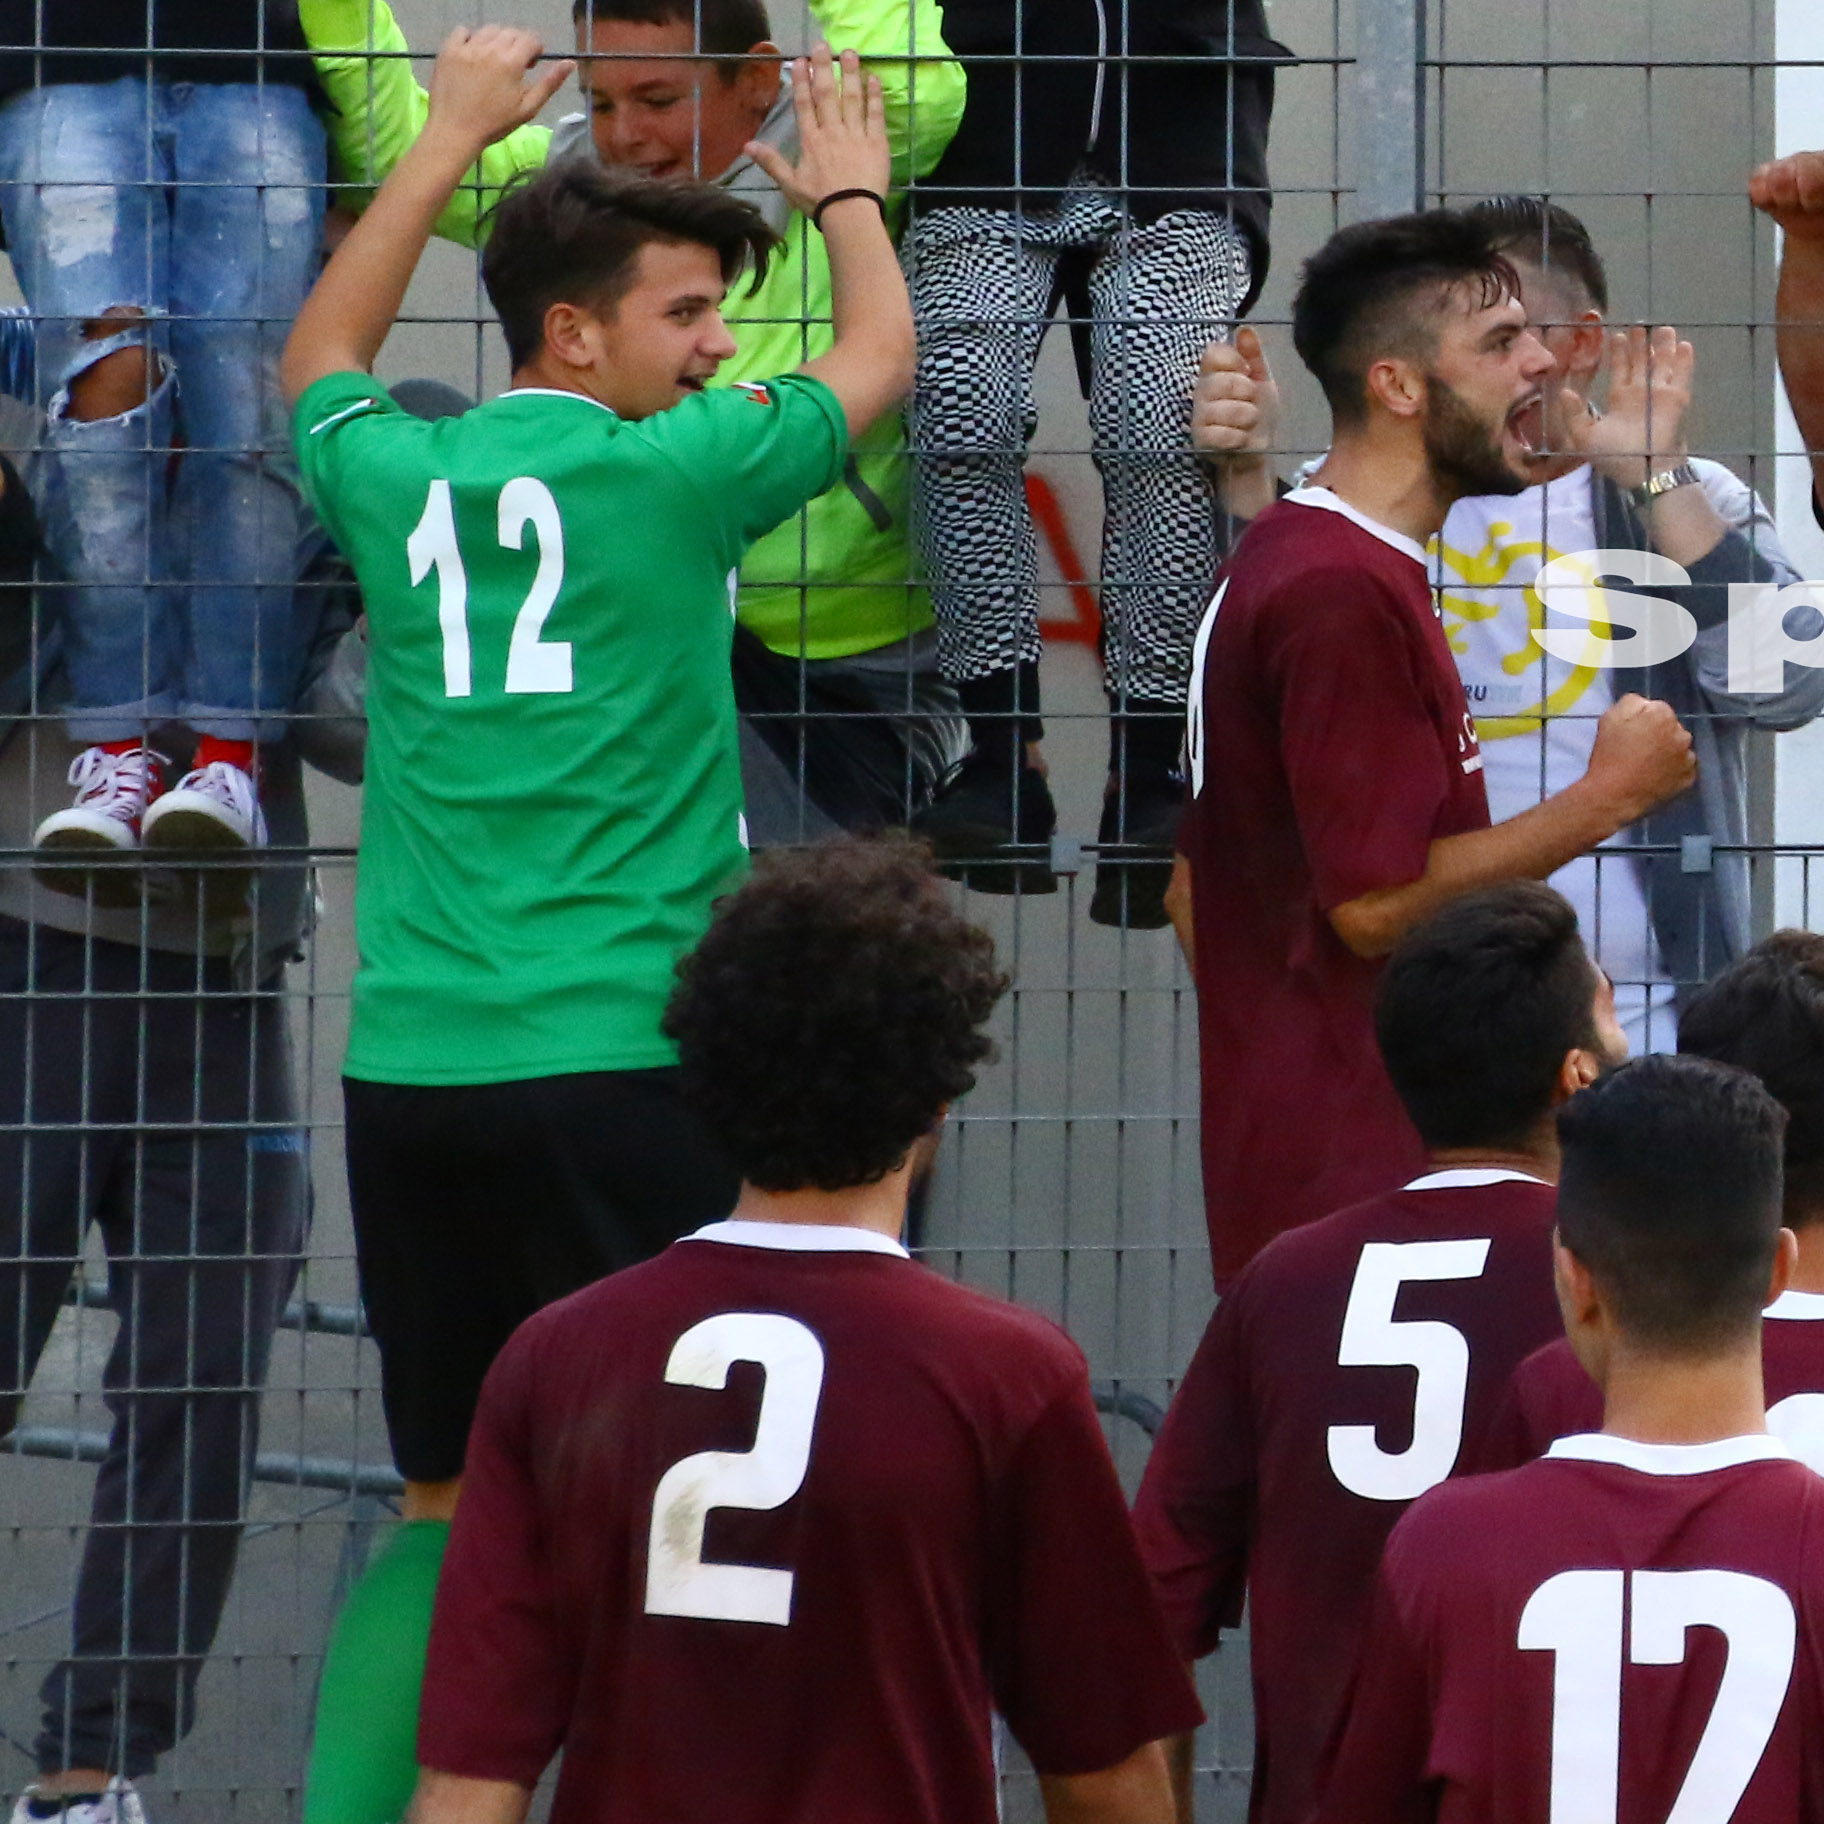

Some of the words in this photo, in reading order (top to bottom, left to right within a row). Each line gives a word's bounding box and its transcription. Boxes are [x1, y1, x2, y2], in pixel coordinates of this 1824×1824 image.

[406, 476, 574, 698] 12
[644, 1312, 825, 1627] 2
[1326, 1238, 1492, 1501] 5
